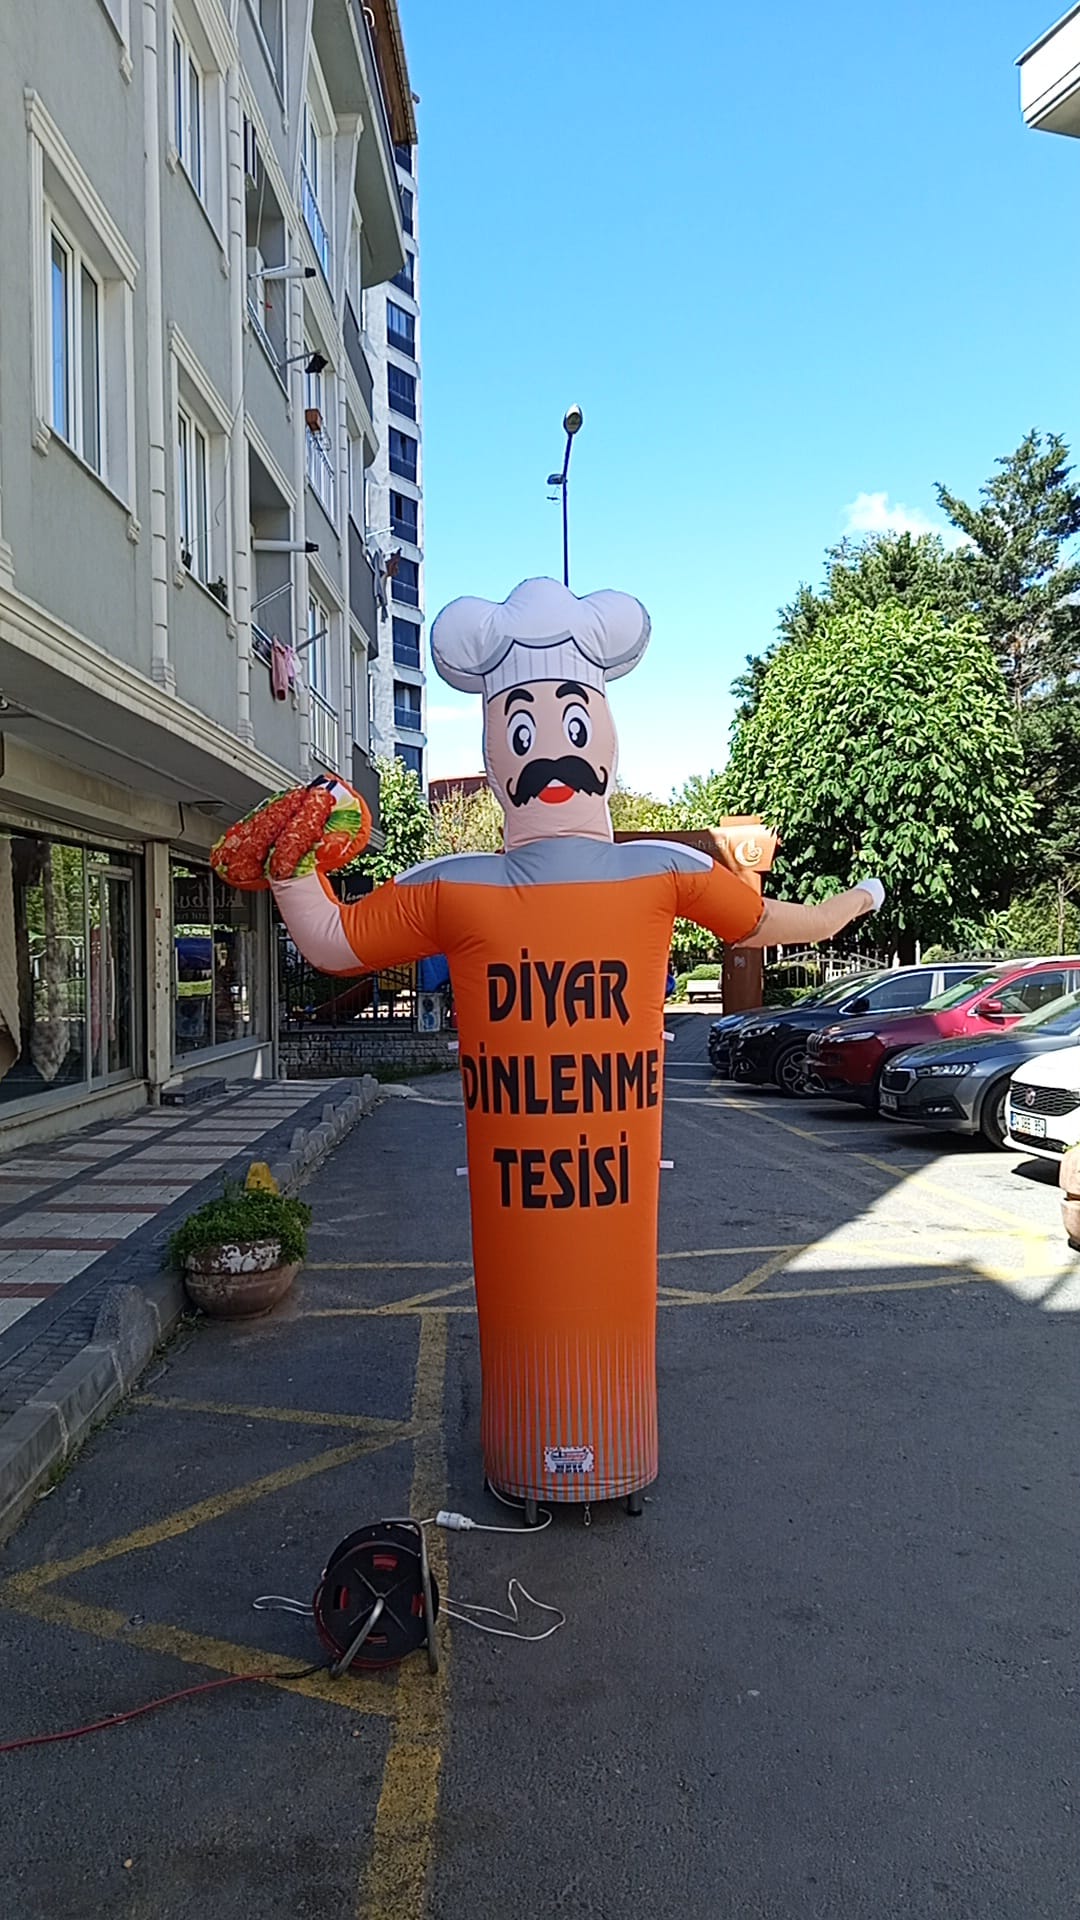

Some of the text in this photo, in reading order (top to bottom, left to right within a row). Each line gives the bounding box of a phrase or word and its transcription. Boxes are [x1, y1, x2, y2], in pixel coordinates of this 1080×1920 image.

[487, 948, 631, 1027] DİYAR
[461, 1042, 659, 1115] DİNLENME
[493, 1131, 629, 1209] TESİSİ
